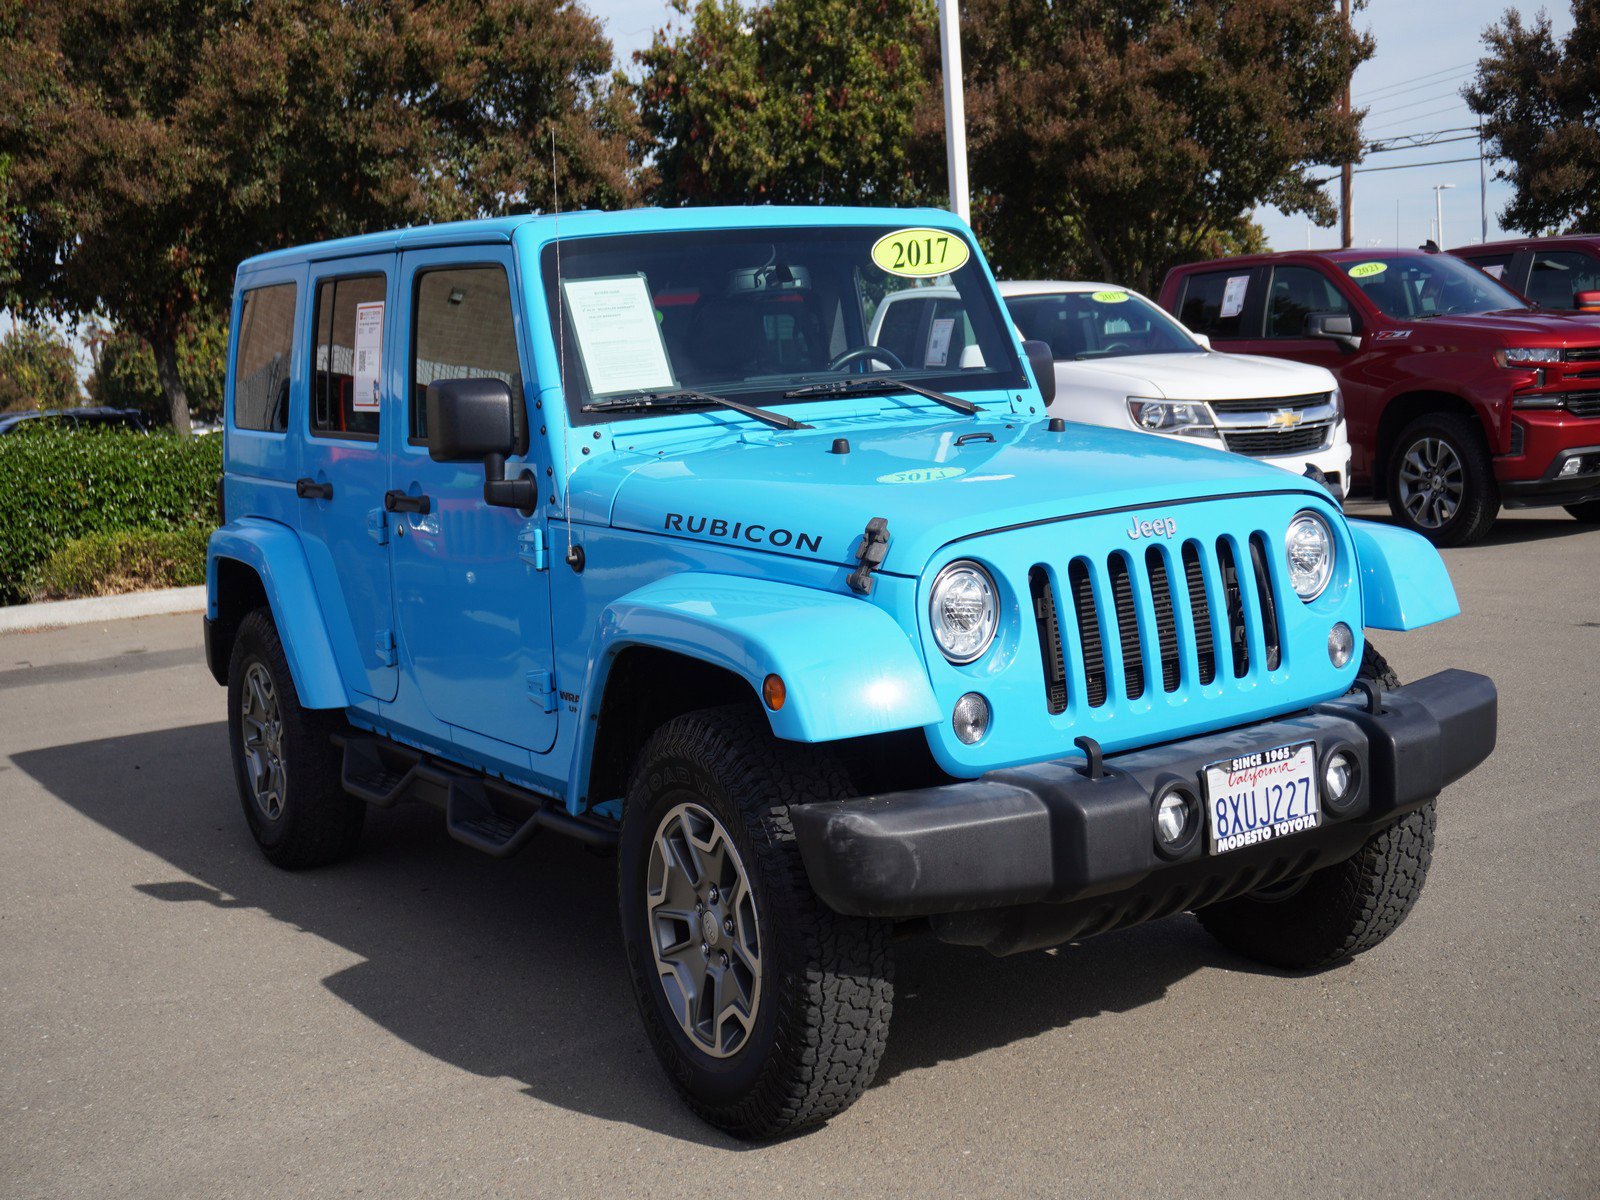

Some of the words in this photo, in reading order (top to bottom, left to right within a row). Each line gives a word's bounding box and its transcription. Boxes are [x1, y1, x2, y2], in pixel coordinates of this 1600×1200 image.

[891, 237, 949, 269] 2017
[1356, 264, 1379, 276] 2021
[1376, 330, 1413, 340] Z71
[664, 512, 823, 553] RUBICON
[1126, 515, 1177, 540] Jeep
[1232, 753, 1262, 771] SINCE
[1265, 747, 1290, 763] 1965
[1229, 763, 1295, 787] California
[1216, 777, 1310, 836] 8XUJ227
[1217, 826, 1272, 853] MODESTO
[1274, 814, 1317, 837] TOYOTA
